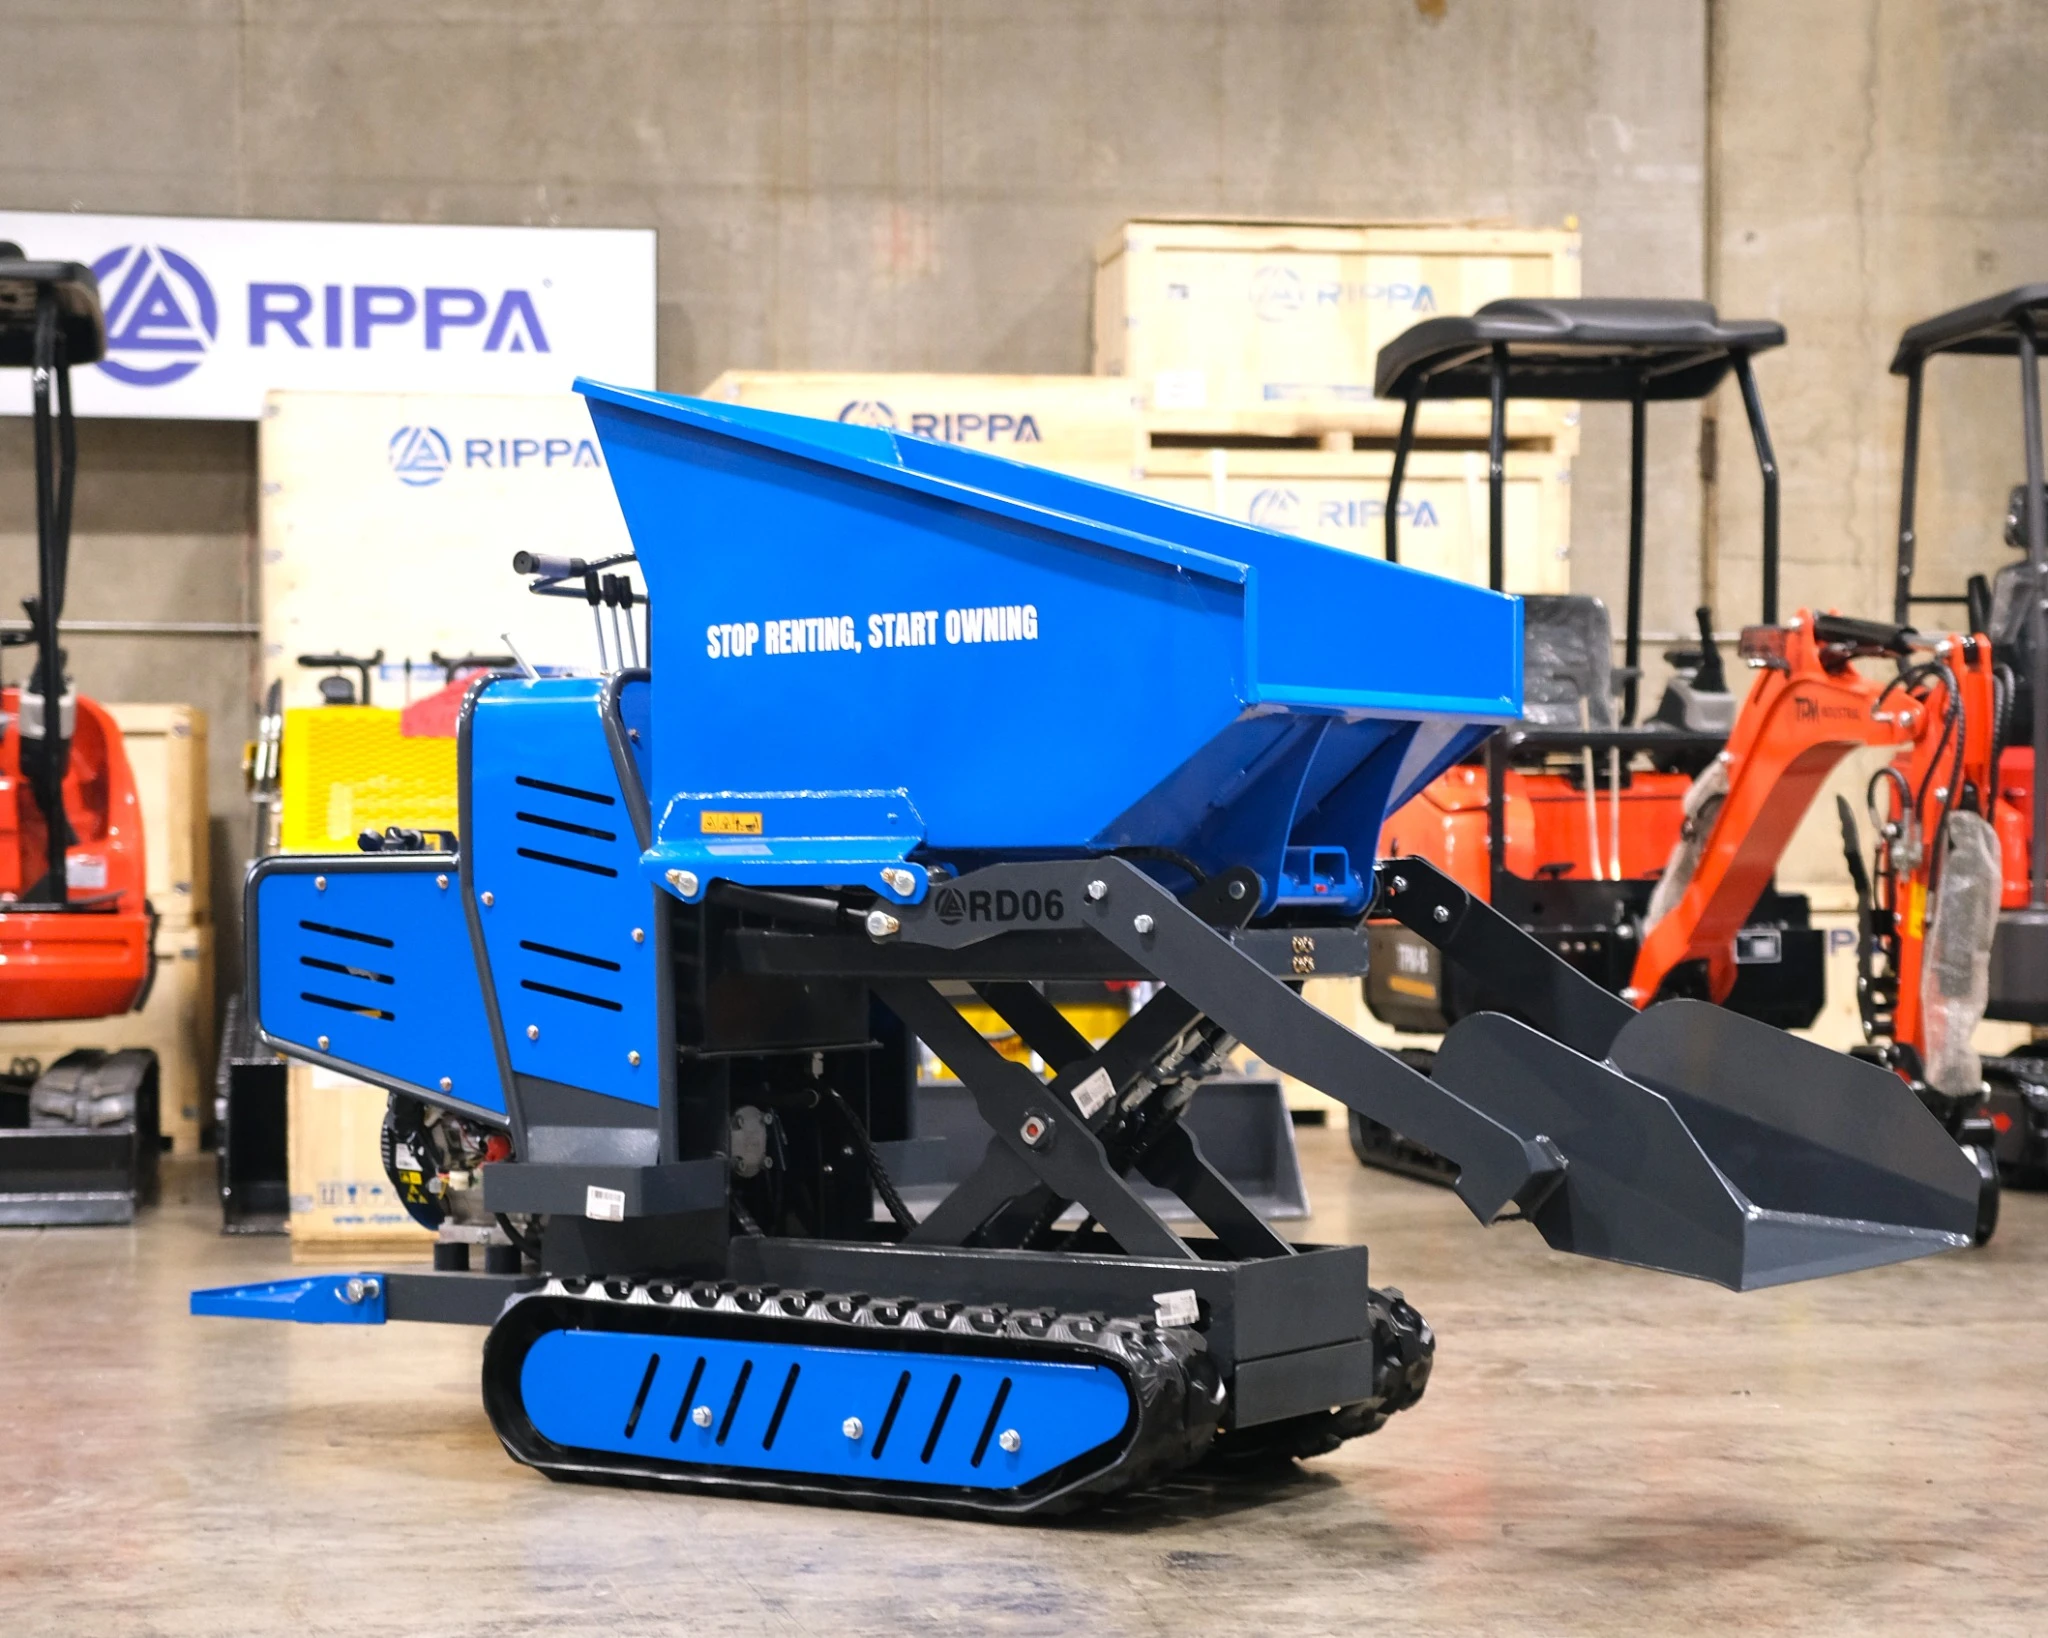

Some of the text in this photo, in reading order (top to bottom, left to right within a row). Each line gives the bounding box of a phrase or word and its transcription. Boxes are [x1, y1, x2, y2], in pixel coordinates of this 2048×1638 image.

[1317, 283, 1438, 313] RIPPA
[248, 283, 552, 353] RIPPA
[910, 413, 1042, 442] RIPPA
[464, 438, 601, 468] RIPPA
[1318, 500, 1439, 528] RIPPA
[706, 604, 1038, 659] STOP RENTING, START OWNING
[969, 889, 1064, 922] RD06
